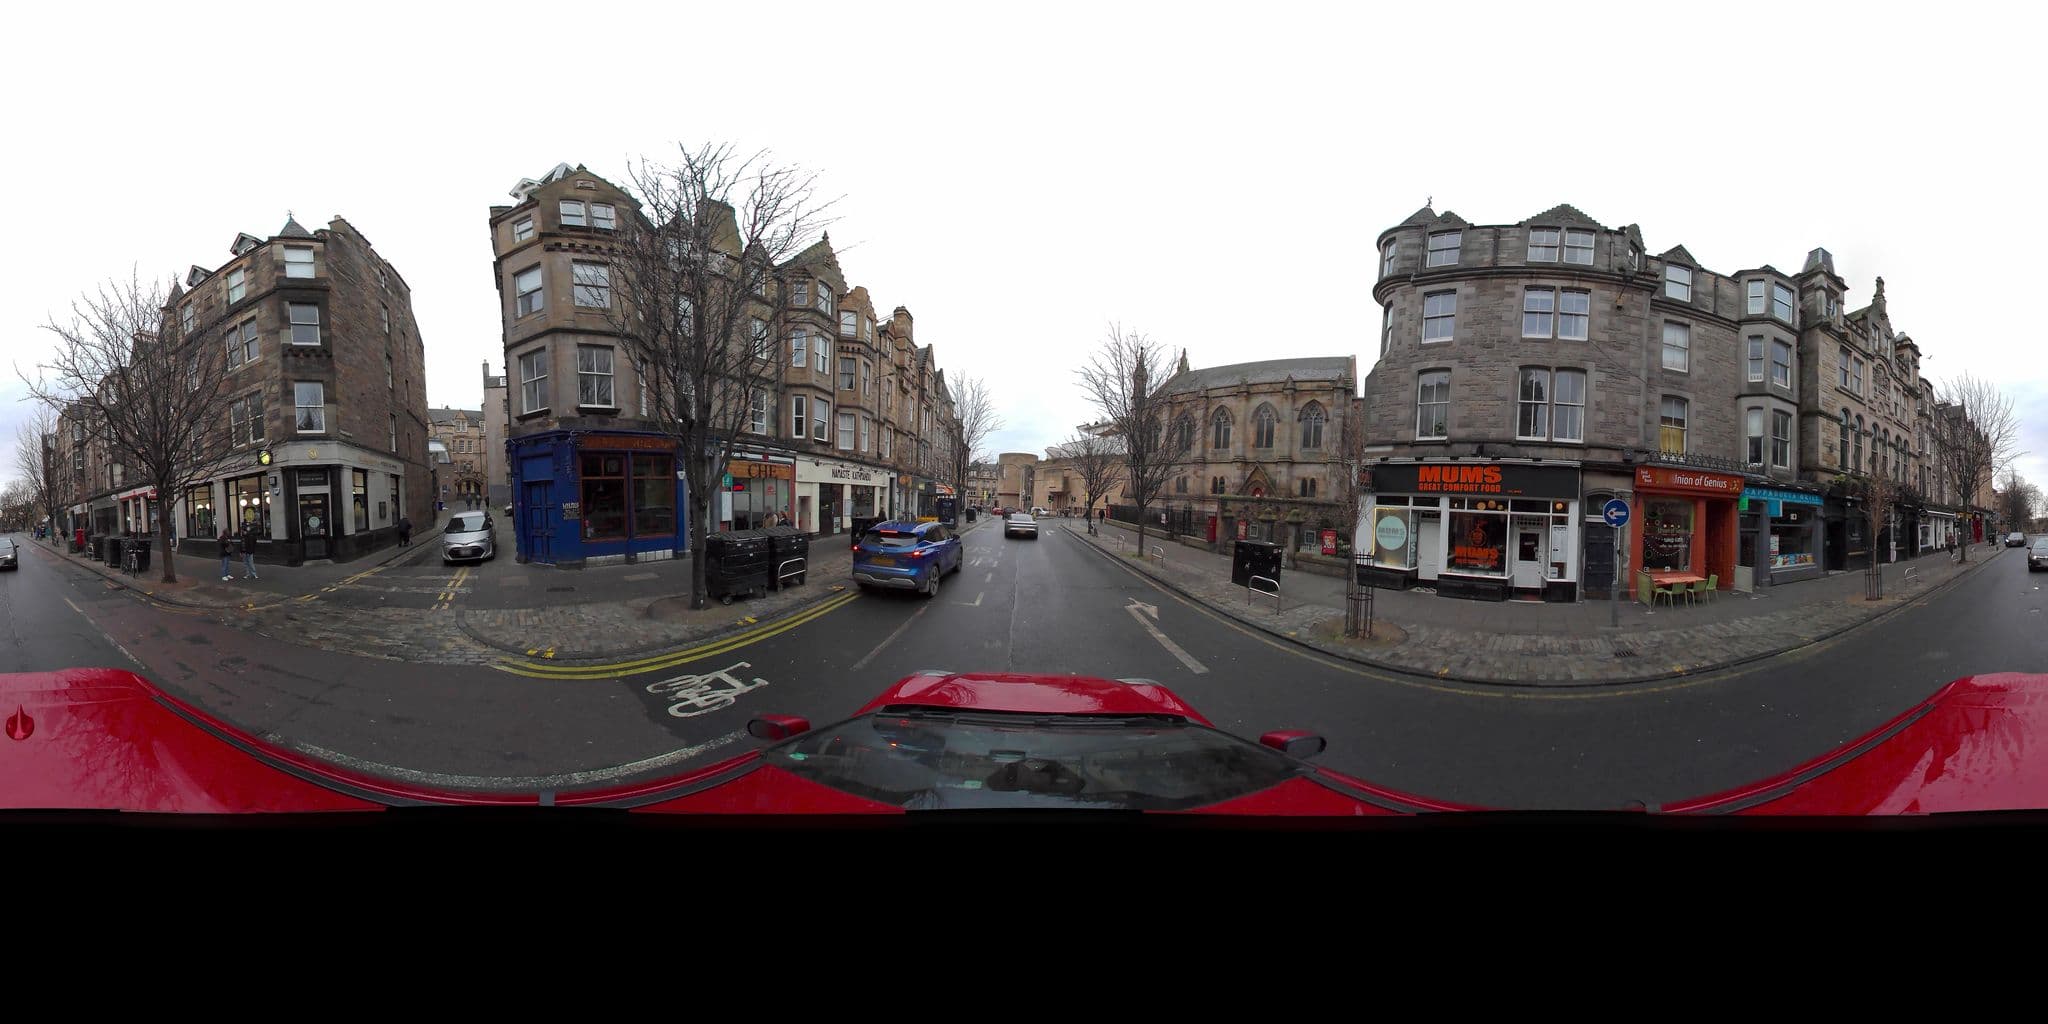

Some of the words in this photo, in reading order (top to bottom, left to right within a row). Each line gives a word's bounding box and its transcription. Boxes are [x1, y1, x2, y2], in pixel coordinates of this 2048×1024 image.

[748, 464, 777, 477] CHE
[831, 468, 850, 480] NAMASTE
[1418, 466, 1503, 483] MUMS
[1418, 483, 1441, 492] GREAT
[1443, 483, 1479, 492] COMFORT
[1481, 484, 1502, 493] FOOD
[1695, 475, 1703, 486] of
[1704, 476, 1727, 489] Genius
[1378, 526, 1405, 536] MUMS
[1455, 546, 1498, 559] MUMS
